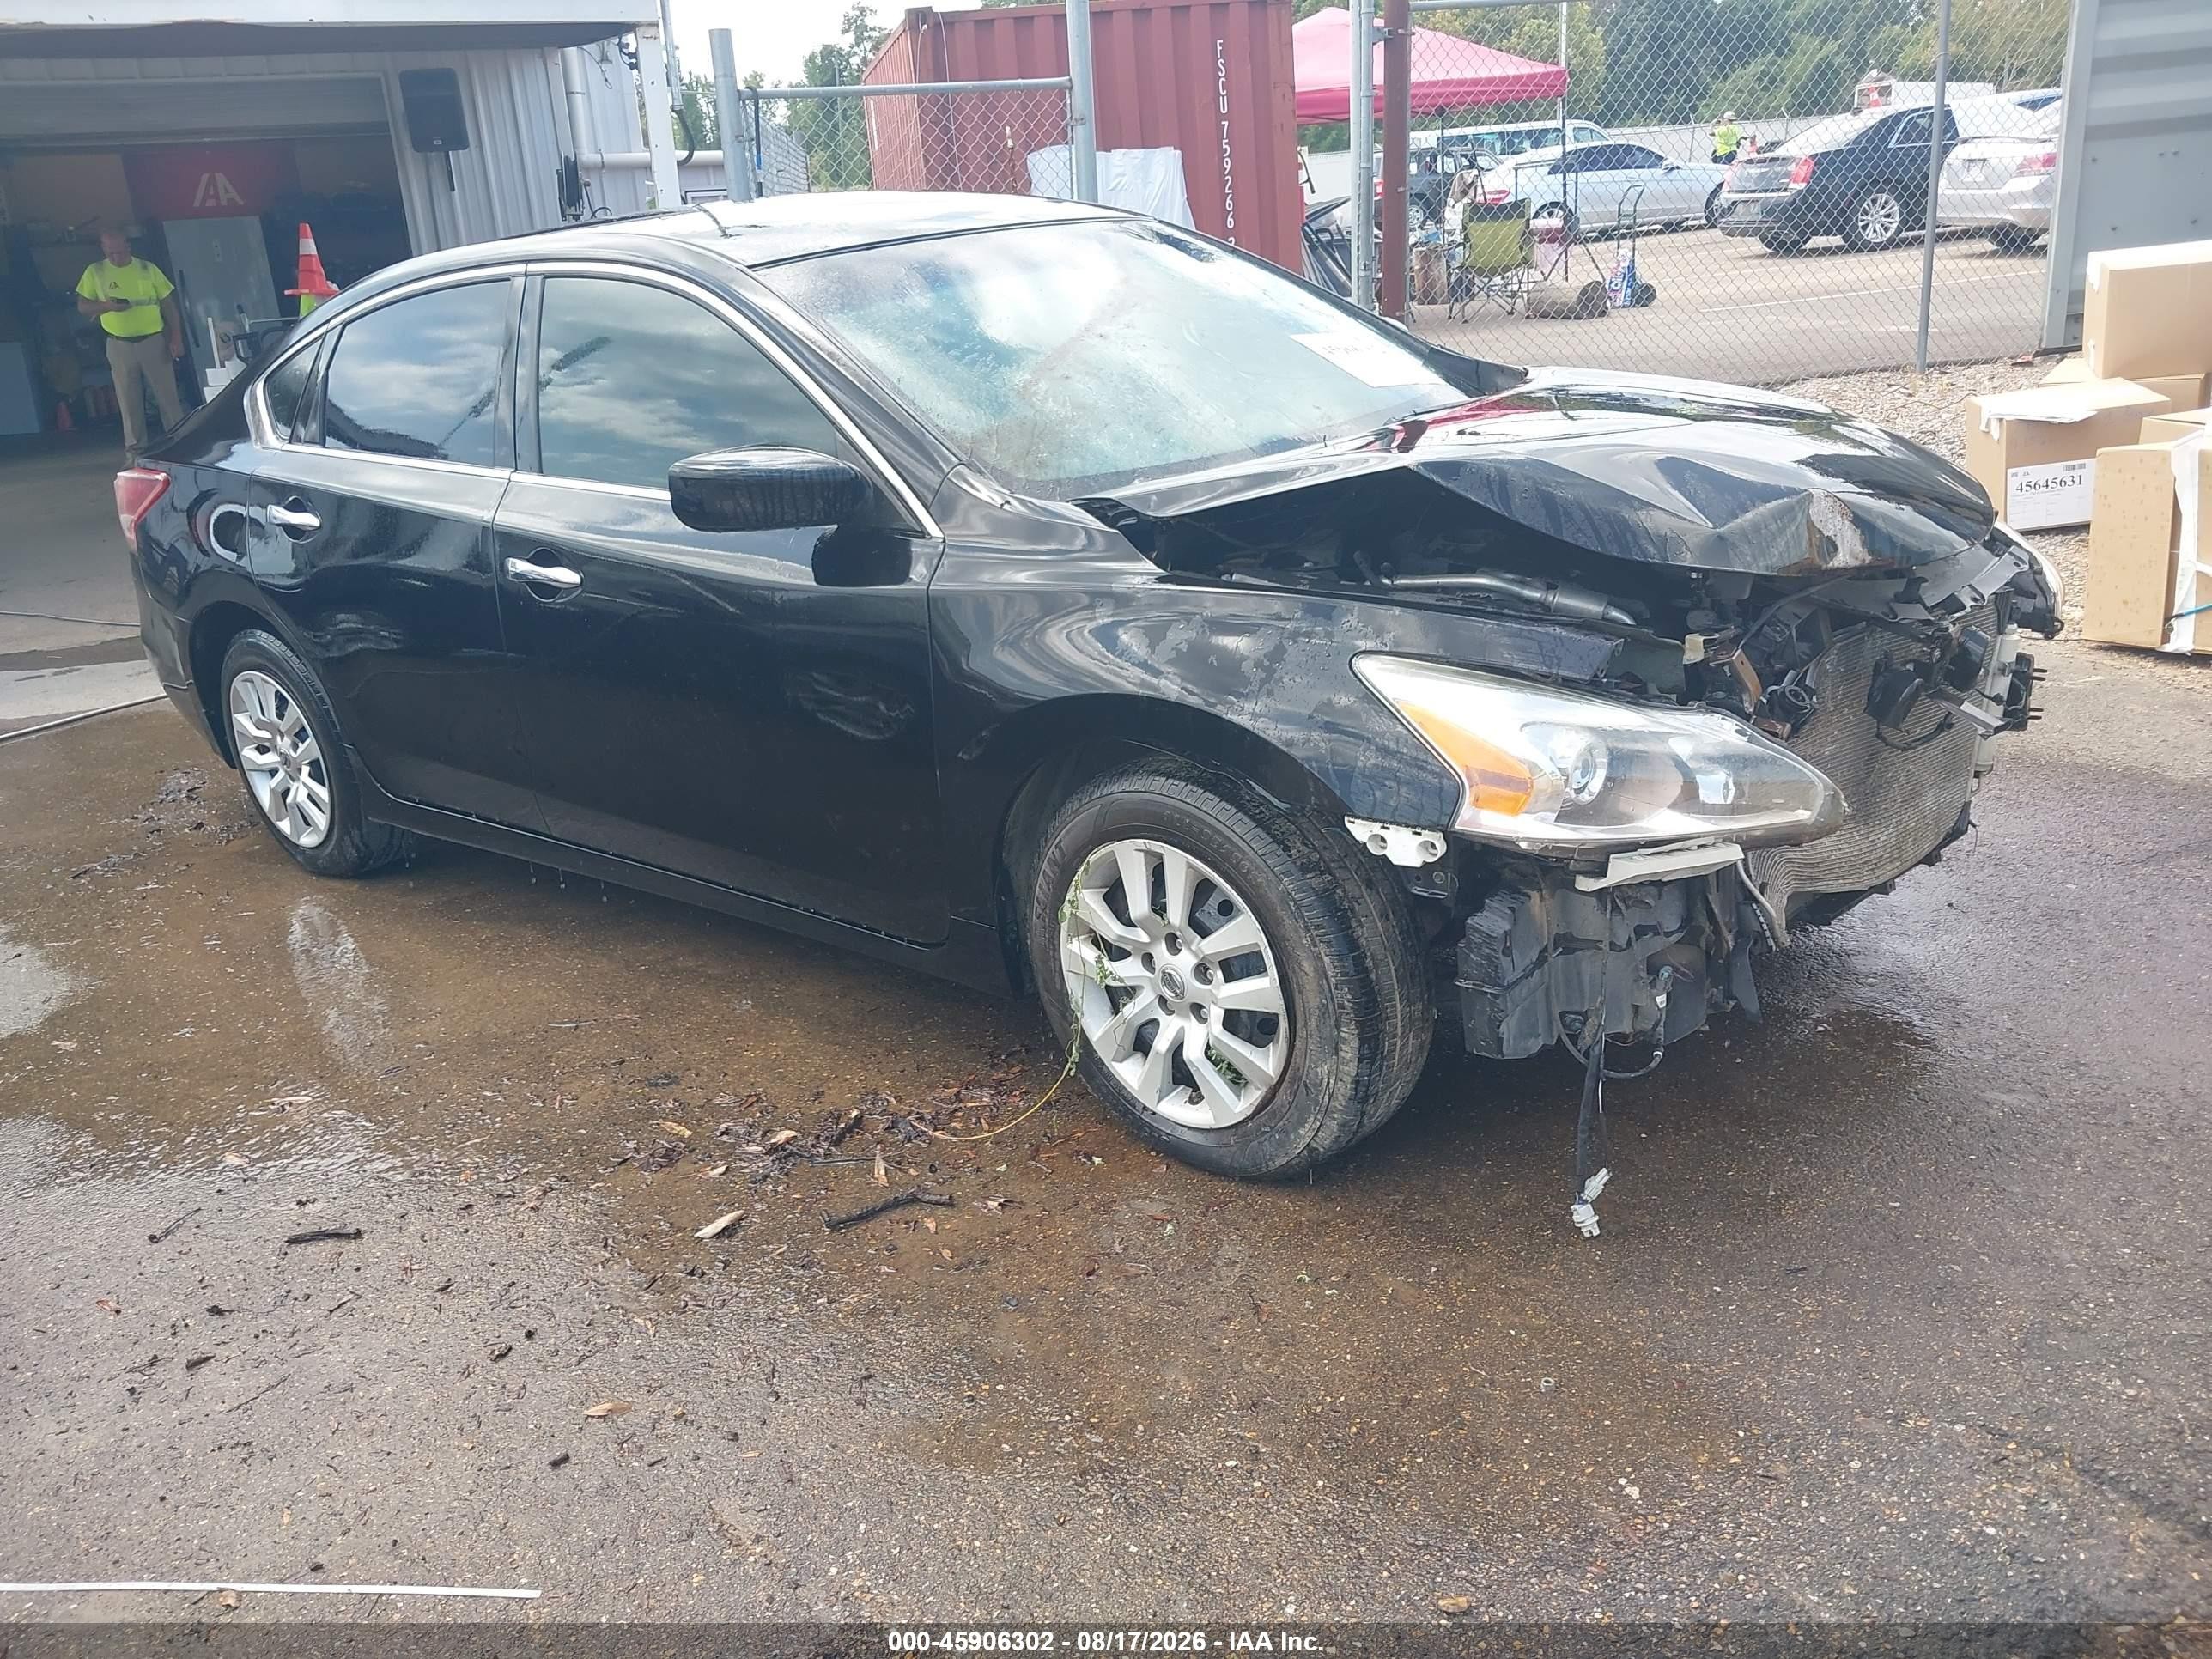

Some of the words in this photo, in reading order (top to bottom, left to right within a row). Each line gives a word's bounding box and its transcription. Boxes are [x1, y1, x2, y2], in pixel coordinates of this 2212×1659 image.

[1216, 40, 1227, 114] FSCU
[1221, 120, 1234, 228] 759266
[2015, 474, 2082, 493] 45645631
